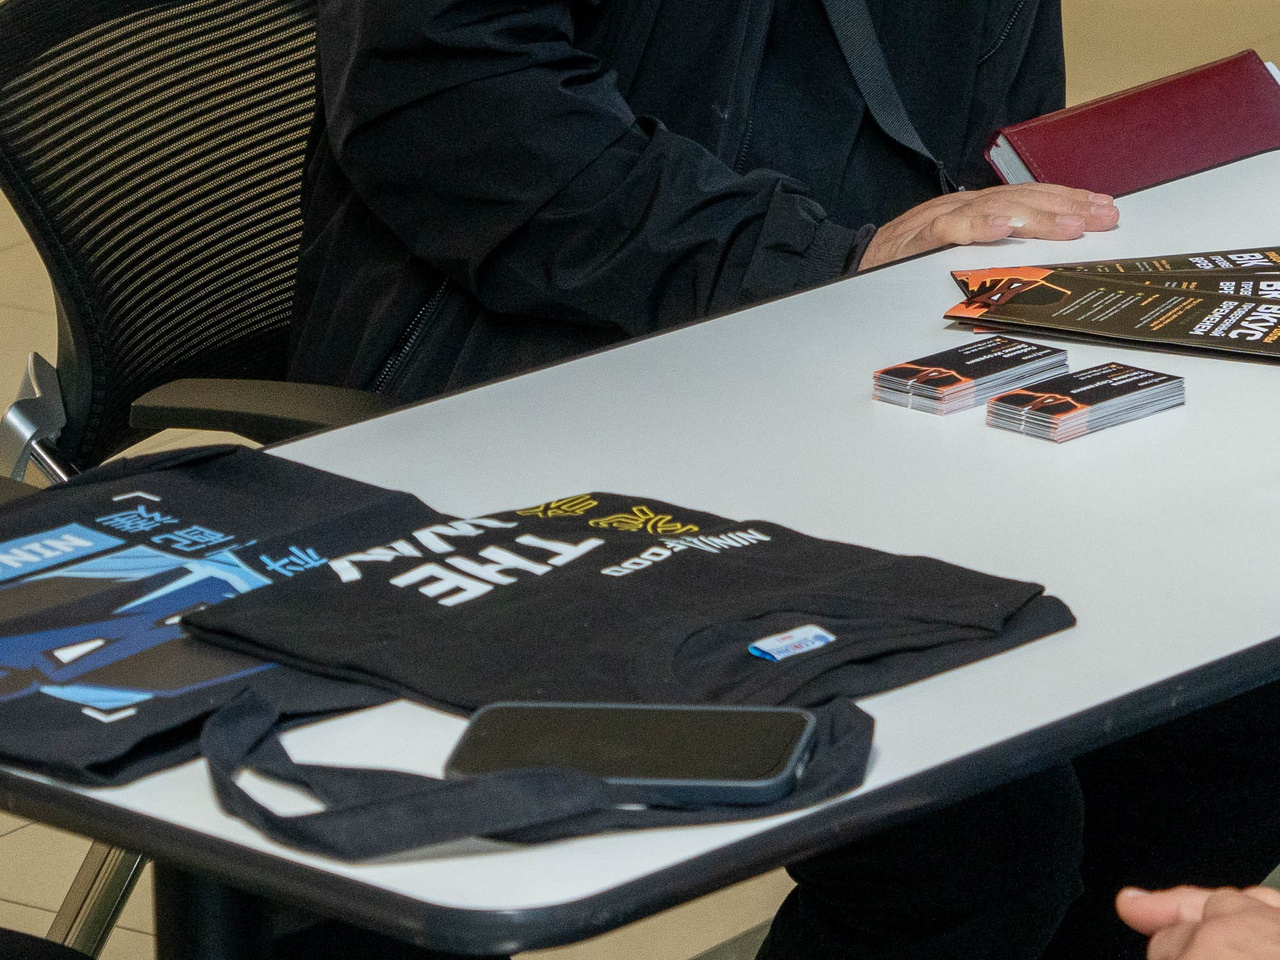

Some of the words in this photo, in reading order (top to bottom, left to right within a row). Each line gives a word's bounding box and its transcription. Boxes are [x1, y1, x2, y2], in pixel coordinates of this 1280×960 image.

[1188, 300, 1239, 336] ВРЕМЕНЕМ
[1209, 302, 1256, 338] ПРОВЕРЕННЫЙ
[389, 534, 605, 608] THE
[600, 541, 688, 577] FOOD
